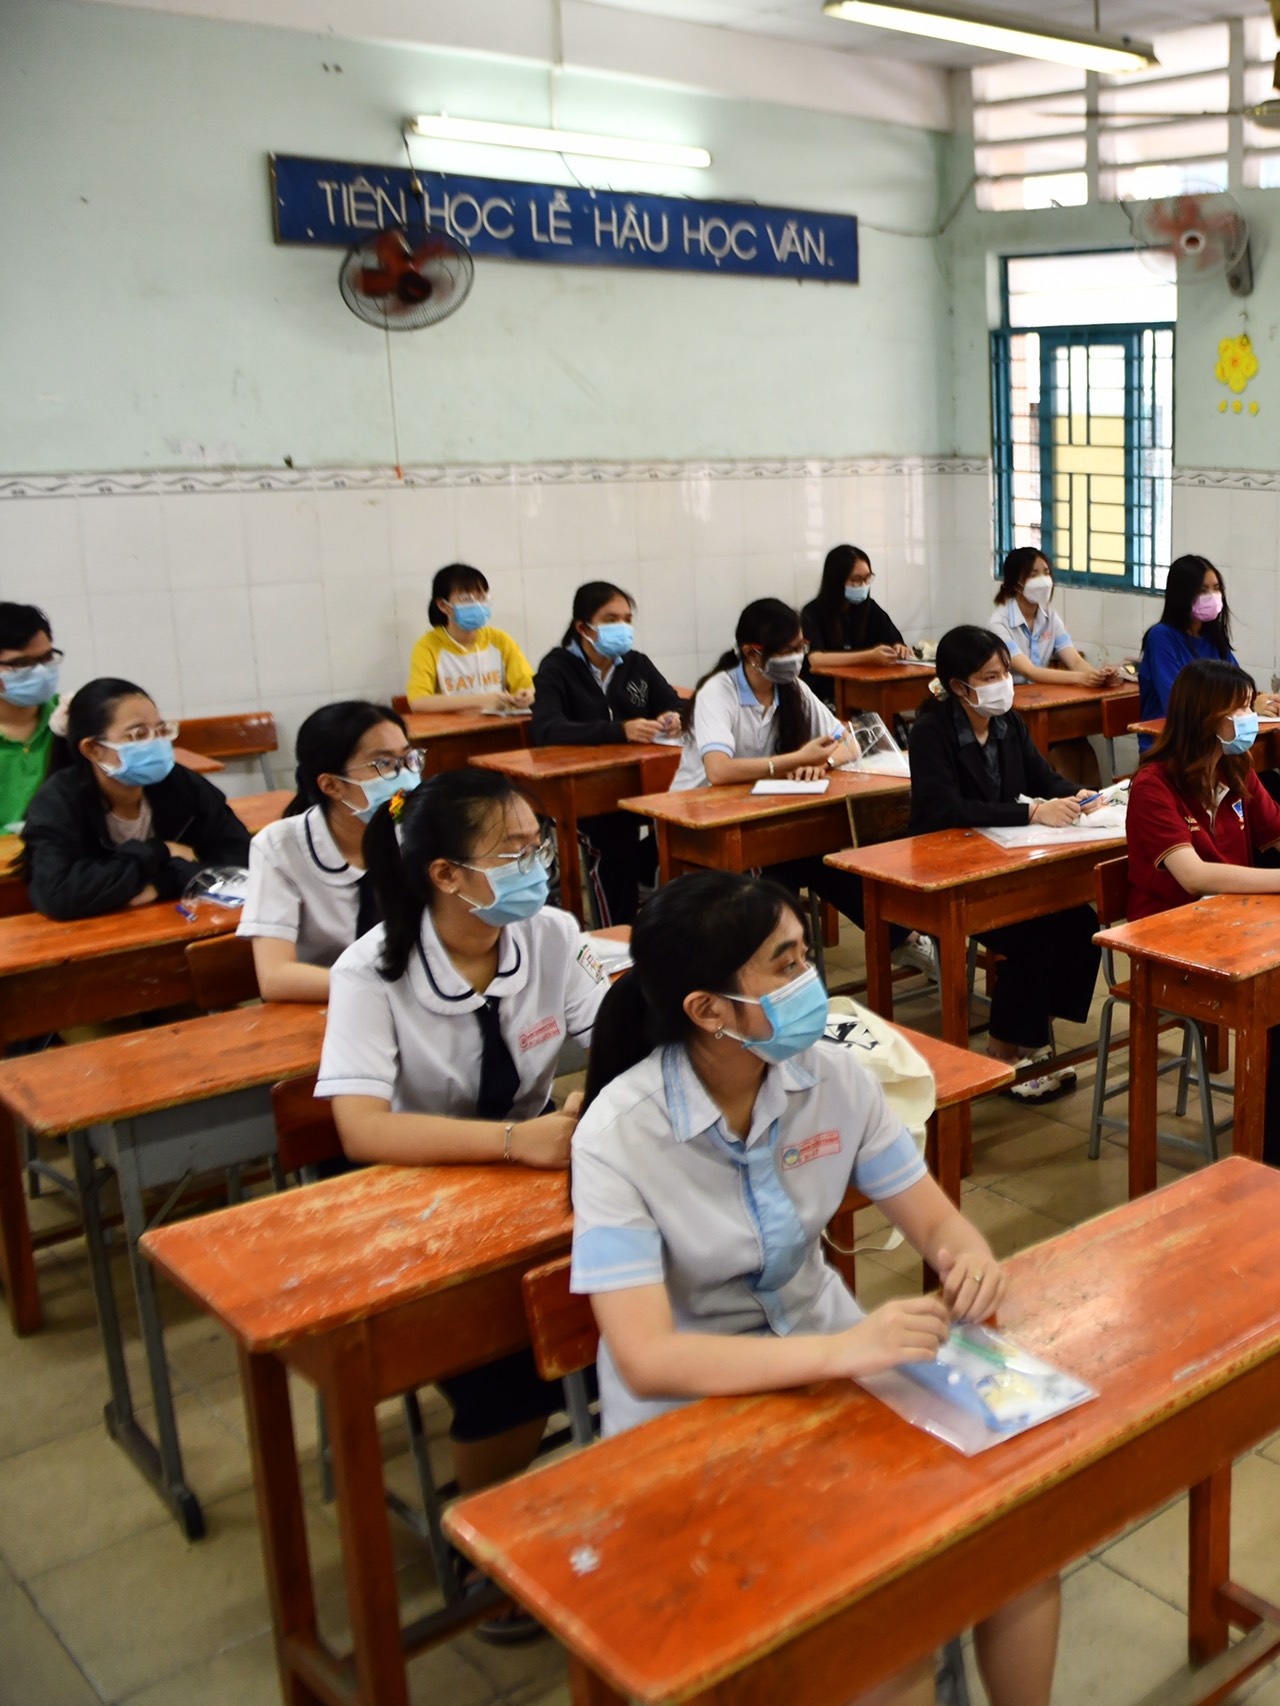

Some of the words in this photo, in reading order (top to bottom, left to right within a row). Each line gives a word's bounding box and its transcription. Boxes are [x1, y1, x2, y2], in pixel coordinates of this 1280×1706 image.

[317, 176, 407, 231] TIÊN
[424, 190, 514, 246] HỌC
[529, 190, 572, 245] LỄ
[594, 202, 669, 253] HẬU
[683, 215, 757, 266] HỌC
[444, 674, 474, 691] SAY
